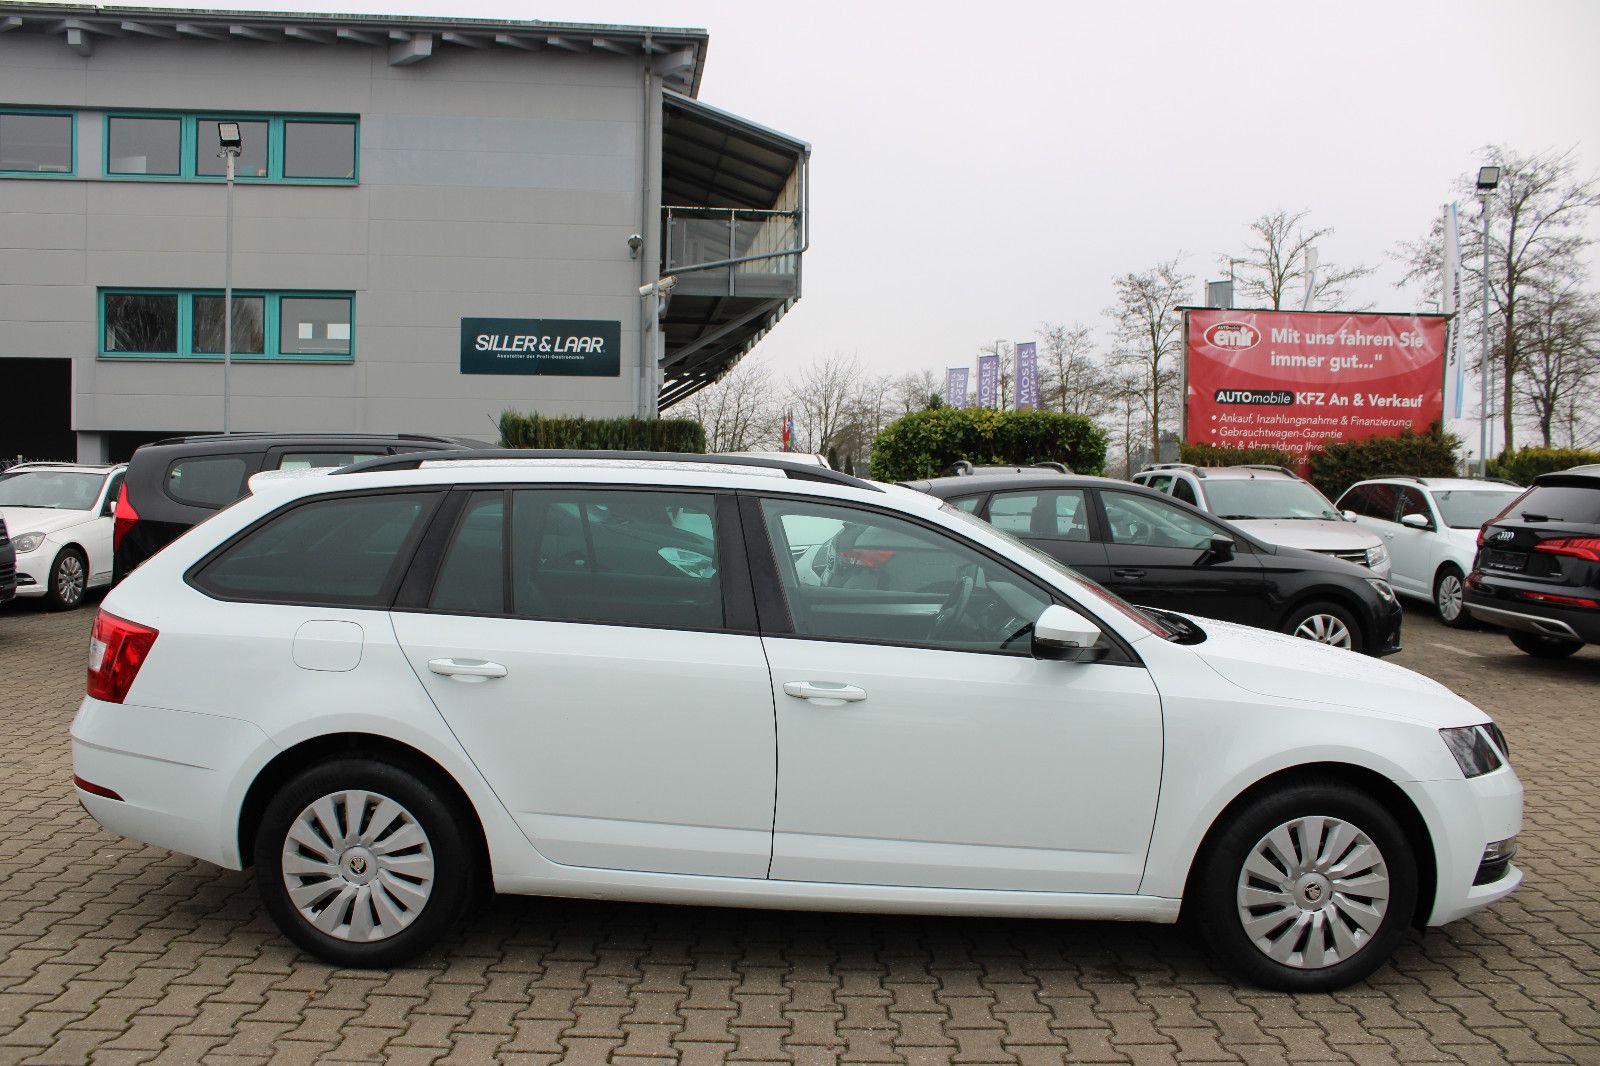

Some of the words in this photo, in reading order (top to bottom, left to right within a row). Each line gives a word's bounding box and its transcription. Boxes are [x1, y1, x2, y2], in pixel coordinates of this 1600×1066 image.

[475, 334, 537, 352] SILLER
[538, 335, 553, 352] &
[1213, 326, 1254, 347] emir
[1271, 328, 1300, 344] Mit
[1305, 333, 1334, 345] uns
[1340, 329, 1393, 346] fahren
[1399, 331, 1423, 348] Sie
[1271, 351, 1325, 367] immer
[1021, 349, 1030, 404] MOSER
[1216, 391, 1291, 404] AUTOmobile
[1296, 392, 1325, 405] KFZ
[1329, 392, 1349, 406] An
[1353, 393, 1364, 406] &
[1368, 393, 1423, 408] Verkauf
[1219, 413, 1254, 424] Ankauf,
[1257, 414, 1338, 426] Inzahlungsnahme
[1340, 416, 1348, 425] &
[1351, 416, 1412, 429] Finanzierung
[1219, 427, 1343, 439] Gebrauchtwagen-Garantie
[1237, 441, 1244, 450] &
